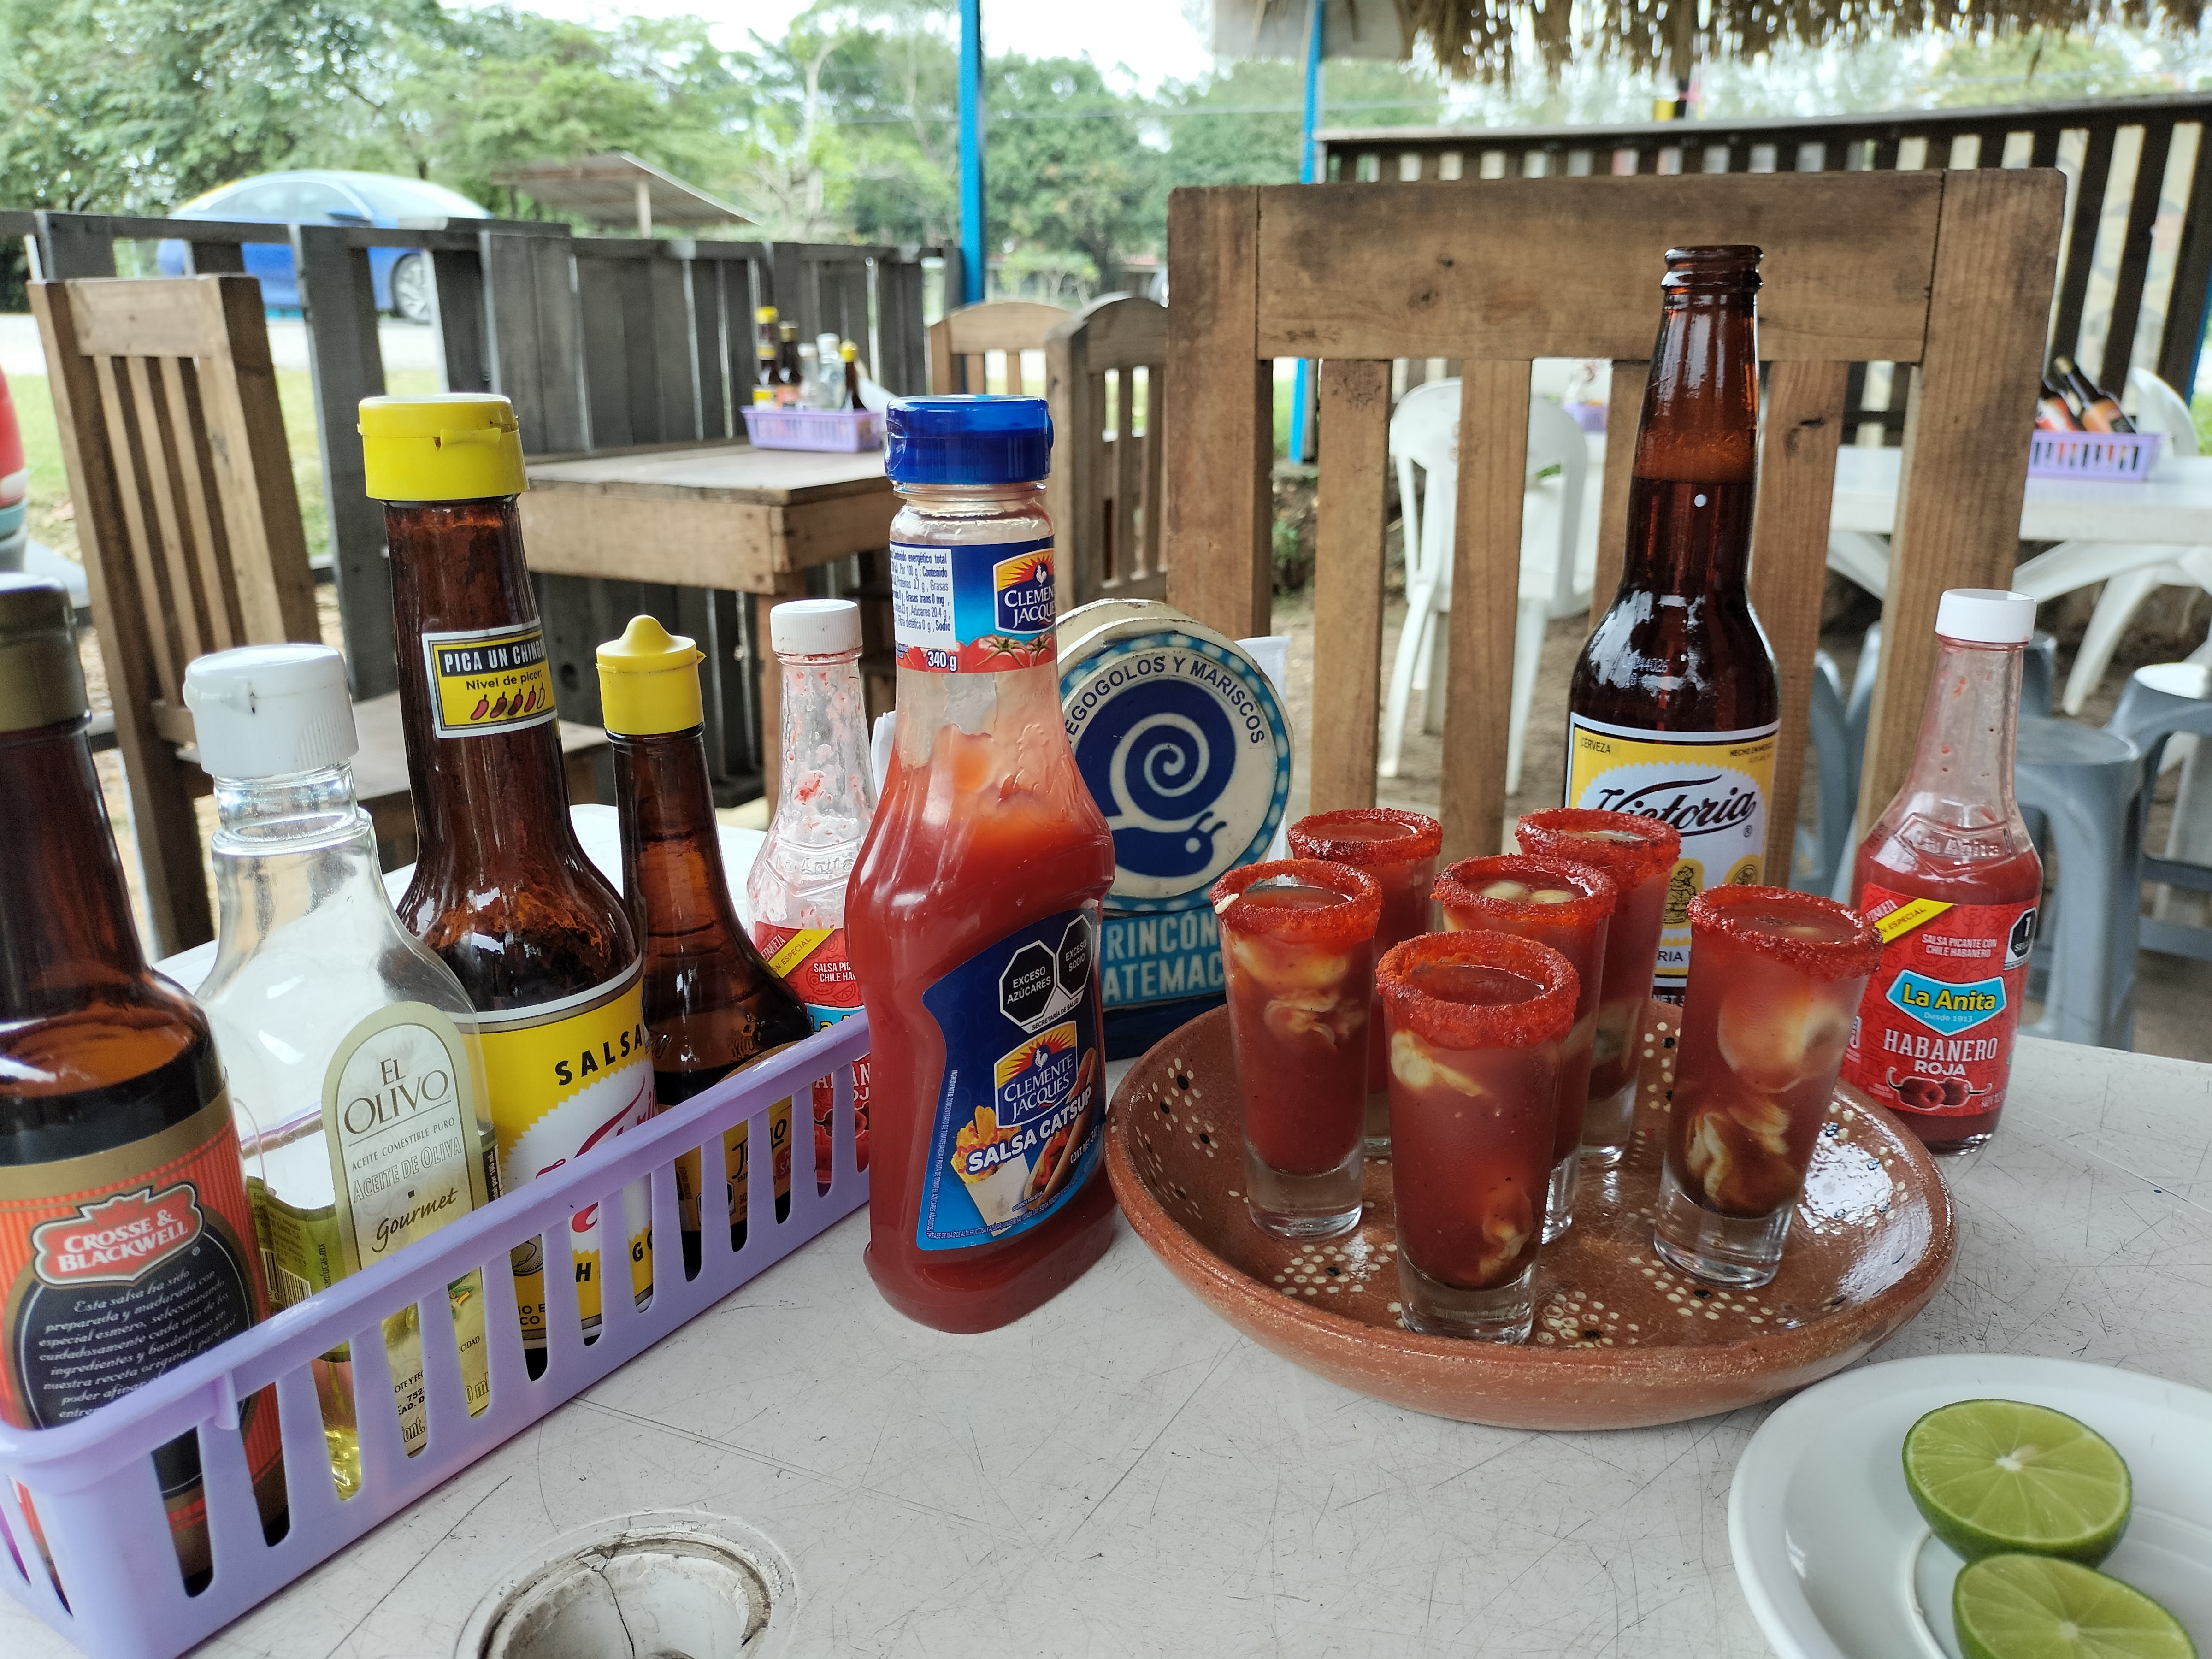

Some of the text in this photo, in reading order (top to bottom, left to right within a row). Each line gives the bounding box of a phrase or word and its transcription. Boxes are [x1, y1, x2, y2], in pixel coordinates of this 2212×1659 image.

[908, 552, 947, 566] energético total
[922, 566, 947, 578] Contenido
[930, 579, 948, 591] Grasas
[1004, 584, 1055, 607] CLEMEN
[920, 593, 931, 604] trans
[911, 604, 931, 617] Azúcares
[1013, 601, 1056, 628] JACQUE
[936, 620, 950, 631] Sodio
[444, 651, 483, 673] PICA
[488, 648, 508, 669] UN
[928, 651, 957, 671] 340 g
[466, 678, 499, 690] Nivel
[503, 675, 517, 686] de
[1065, 656, 1264, 744] EGOGOLOS Y MARISCOS
[1581, 737, 1610, 754] CERVEZA
[1730, 747, 1750, 757] HECHO
[1888, 907, 1927, 930] ESPECIAL
[1107, 911, 1219, 961] RINCÓN
[1922, 934, 1947, 945] SALSA
[1949, 938, 1982, 948] PICANTE
[782, 938, 812, 965] ESPECIAL
[1066, 939, 1087, 962] EXCESO
[1926, 945, 1991, 957] CHILE HABANERO
[814, 962, 838, 973] SALSA
[1068, 953, 1085, 972] SODIO
[820, 973, 841, 982] CHILE
[1013, 966, 1046, 988] EXCESO
[1007, 976, 1051, 1004] AZÚCARES
[1903, 983, 1996, 1010] La Anita
[1032, 1010, 1060, 1031] SECRETARÍA
[1067, 998, 1079, 1011] SALUD
[1923, 1012, 1951, 1022] Desde
[555, 1024, 643, 1086] SALSA
[1882, 1028, 1998, 1062] HABANERO
[380, 1058, 406, 1086] EL
[1004, 1053, 1073, 1102] CLEMENTE
[1914, 1061, 1966, 1075] ROJA
[947, 1070, 958, 1097] INGREDIENTES:
[344, 1069, 449, 1134] OLIVO
[1012, 1072, 1069, 1123] JACQUES
[943, 1098, 953, 1125] CONCENTRADO
[938, 1130, 948, 1144] TOMATE
[968, 1086, 1091, 1172] SALSA CATSUP
[352, 1117, 455, 1171] ACEITE COMESTIBLE PURO
[1070, 1146, 1083, 1163] CONT.
[354, 1137, 463, 1204] ACEITE DE OLIVA
[935, 1160, 943, 1171] PASTA
[929, 1193, 938, 1212] AZÚCARES
[64, 1209, 179, 1253] CROSSE &
[372, 1187, 458, 1253] Gourmet
[926, 1212, 937, 1230] AÑADIDOS
[969, 1227, 986, 1236] FRUCTOSA
[946, 1230, 956, 1239] MAÍZ
[57, 1222, 188, 1273] BLACKWELL
[74, 1268, 190, 1312] Esta salsa ha sido
[39, 1328, 94, 1349] especial
[151, 1276, 224, 1323] seleccionando
[45, 1271, 215, 1335] preparada y madurada con
[39, 1293, 228, 1361] cuidadosamente cada uno de los
[51, 1355, 133, 1379] ingredientes
[136, 1352, 145, 1364] y
[215, 1310, 226, 1321] en
[44, 1379, 93, 1390] nuestra
[95, 1368, 138, 1385] receta
[197, 1328, 221, 1352] para
[408, 1376, 413, 1385] Y
[62, 1389, 100, 1406] poder
[407, 1387, 425, 1402] 752
[399, 1403, 417, 1416] AD.
[402, 1416, 425, 1442] ont.
